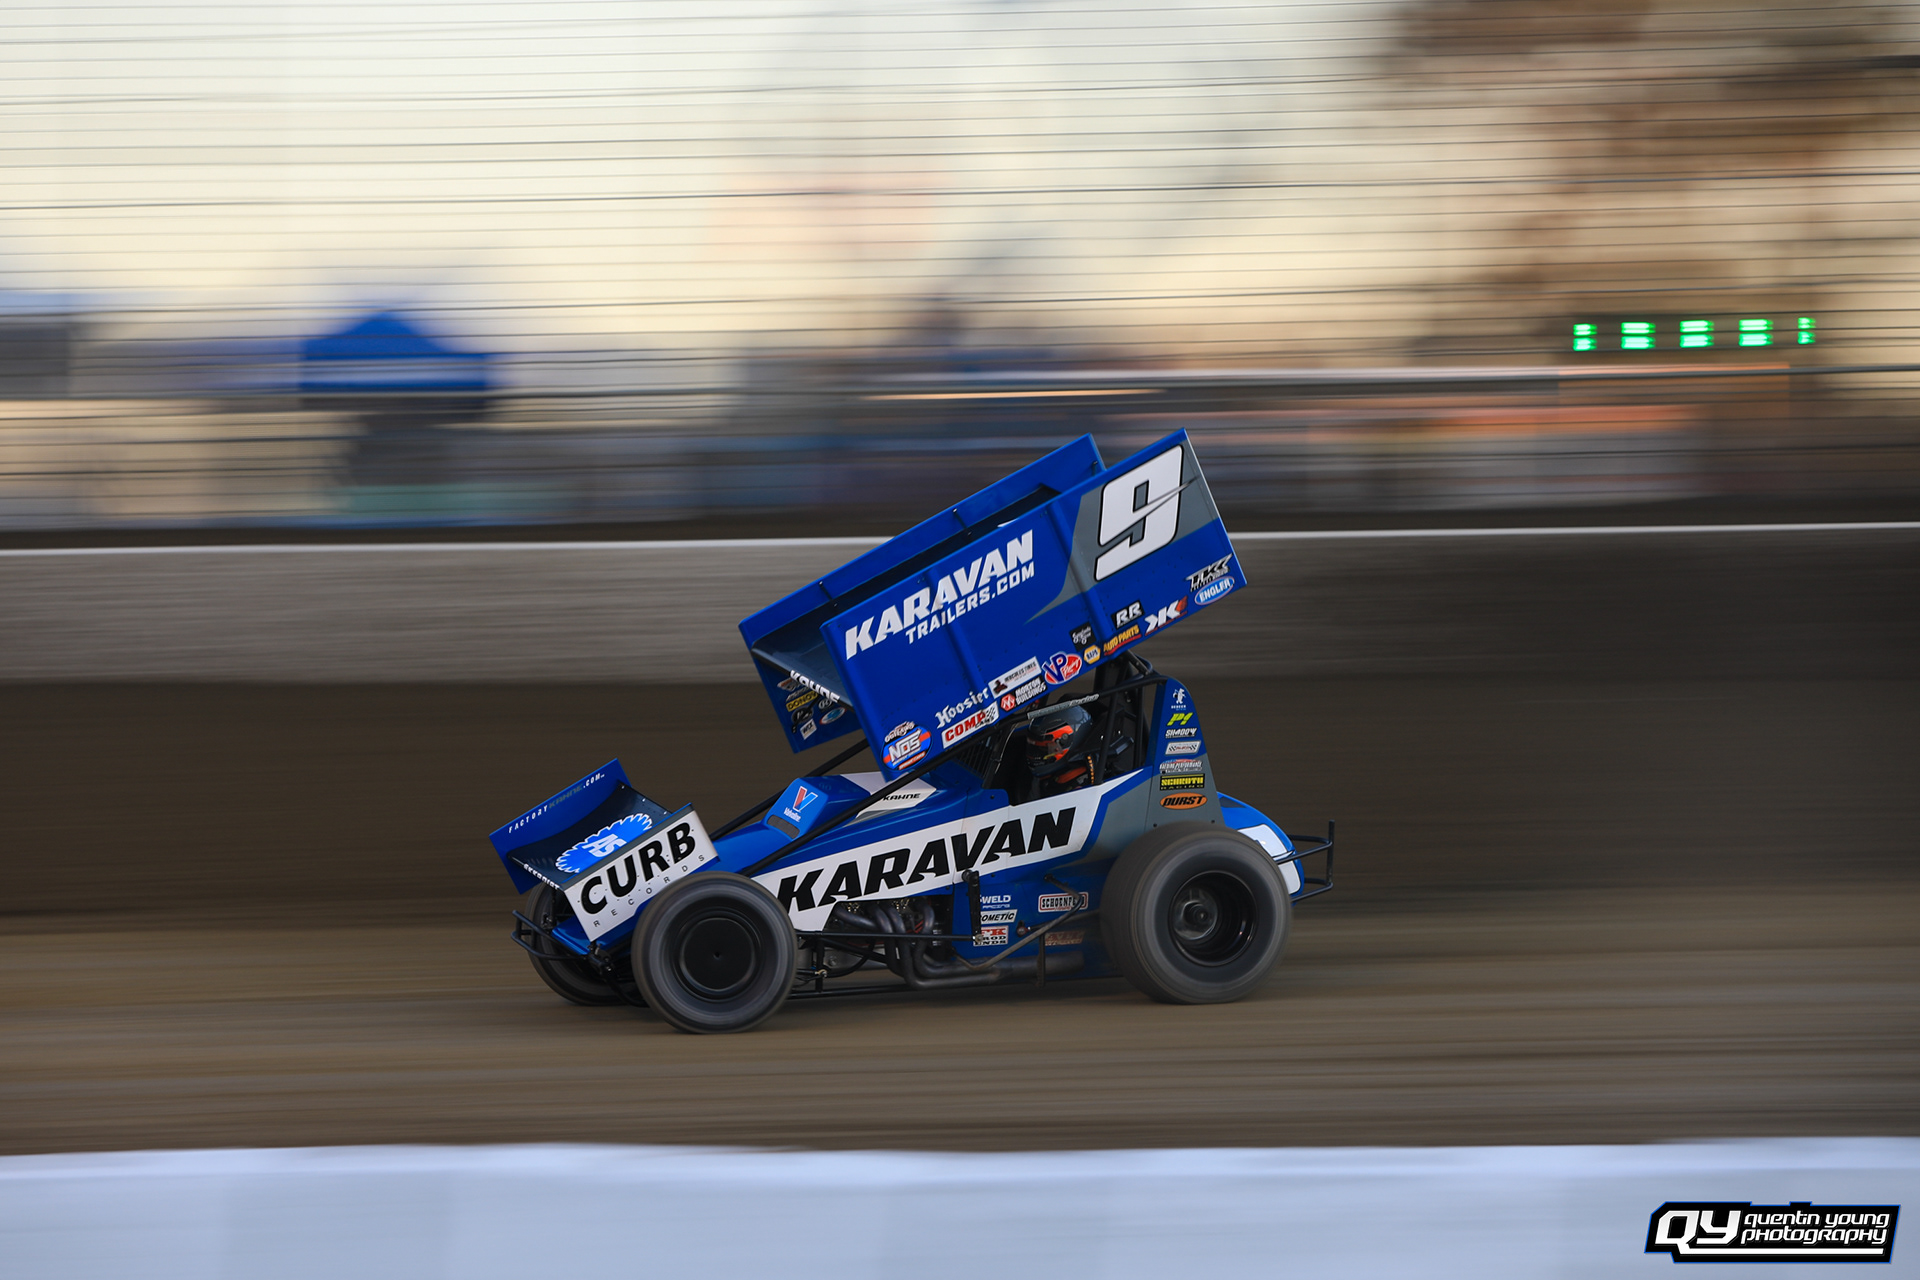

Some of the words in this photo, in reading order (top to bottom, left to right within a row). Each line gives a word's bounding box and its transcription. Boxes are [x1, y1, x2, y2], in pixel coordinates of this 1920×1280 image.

[1095, 445, 1184, 581] 9
[846, 529, 1034, 660] KARAVAN
[905, 561, 1035, 646] TRAILERS.COM
[1199, 578, 1231, 602] ENGLER
[1116, 601, 1142, 628] RR
[1103, 636, 1119, 652] AUTO
[1118, 625, 1140, 643] PARTS
[1042, 652, 1068, 683] VP
[1015, 677, 1040, 697] MORTON
[1016, 682, 1046, 705] BUILDINGS
[935, 687, 989, 729] Hoosier
[945, 710, 986, 741] COMP
[1165, 728, 1197, 737] SHADOW
[888, 728, 922, 763] NOS
[1161, 777, 1204, 786] SCHROTH
[883, 793, 921, 801] KAHNE
[1163, 796, 1204, 806] DURST
[580, 822, 697, 915] CURB
[776, 806, 1077, 914] KARAVAN
[593, 855, 706, 928] RECORDS
[982, 895, 1011, 904] WELD
[1042, 894, 1085, 907] SCHOENFED
[980, 912, 1015, 921] OMETIC
